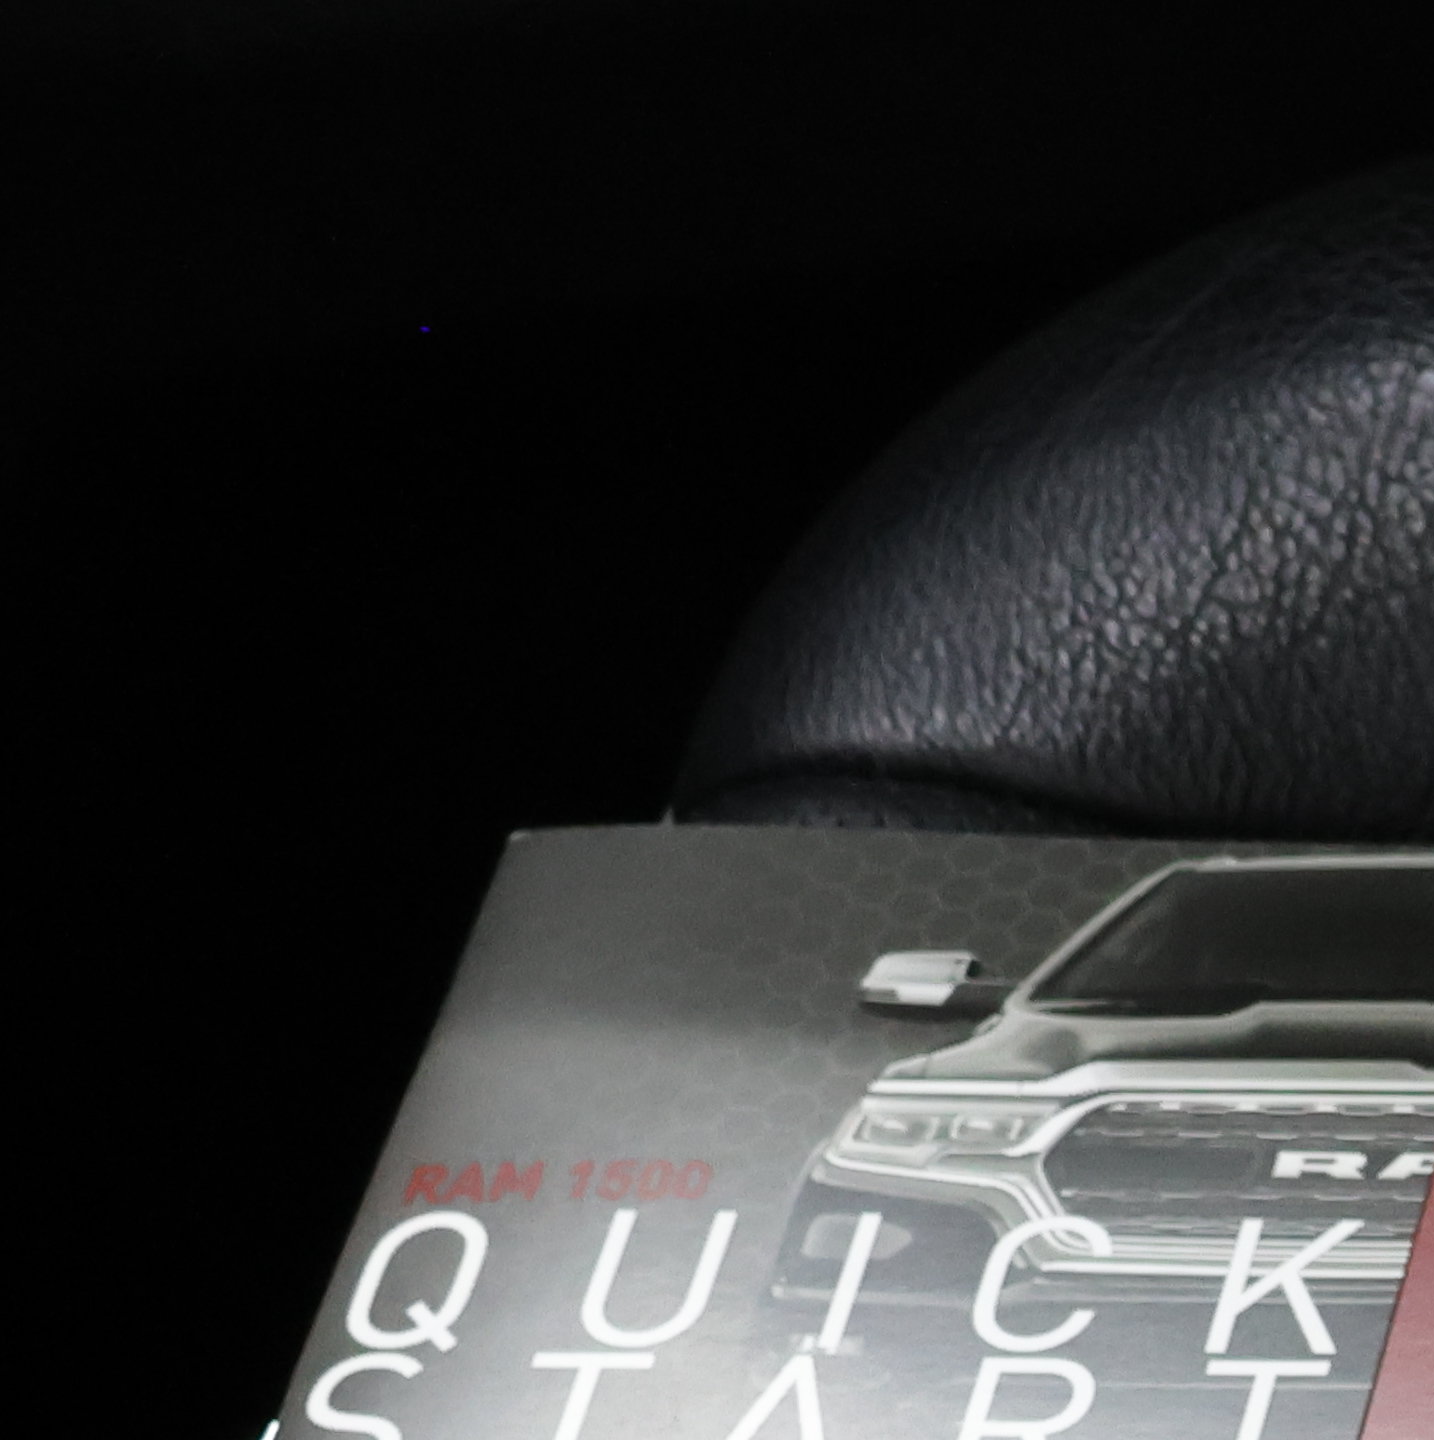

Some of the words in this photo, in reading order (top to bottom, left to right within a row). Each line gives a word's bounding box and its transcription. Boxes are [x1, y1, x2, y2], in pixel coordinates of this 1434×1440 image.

[403, 1159, 545, 1207] RAM
[569, 1158, 713, 1201] 1500
[345, 1209, 1364, 1356] QUICK
